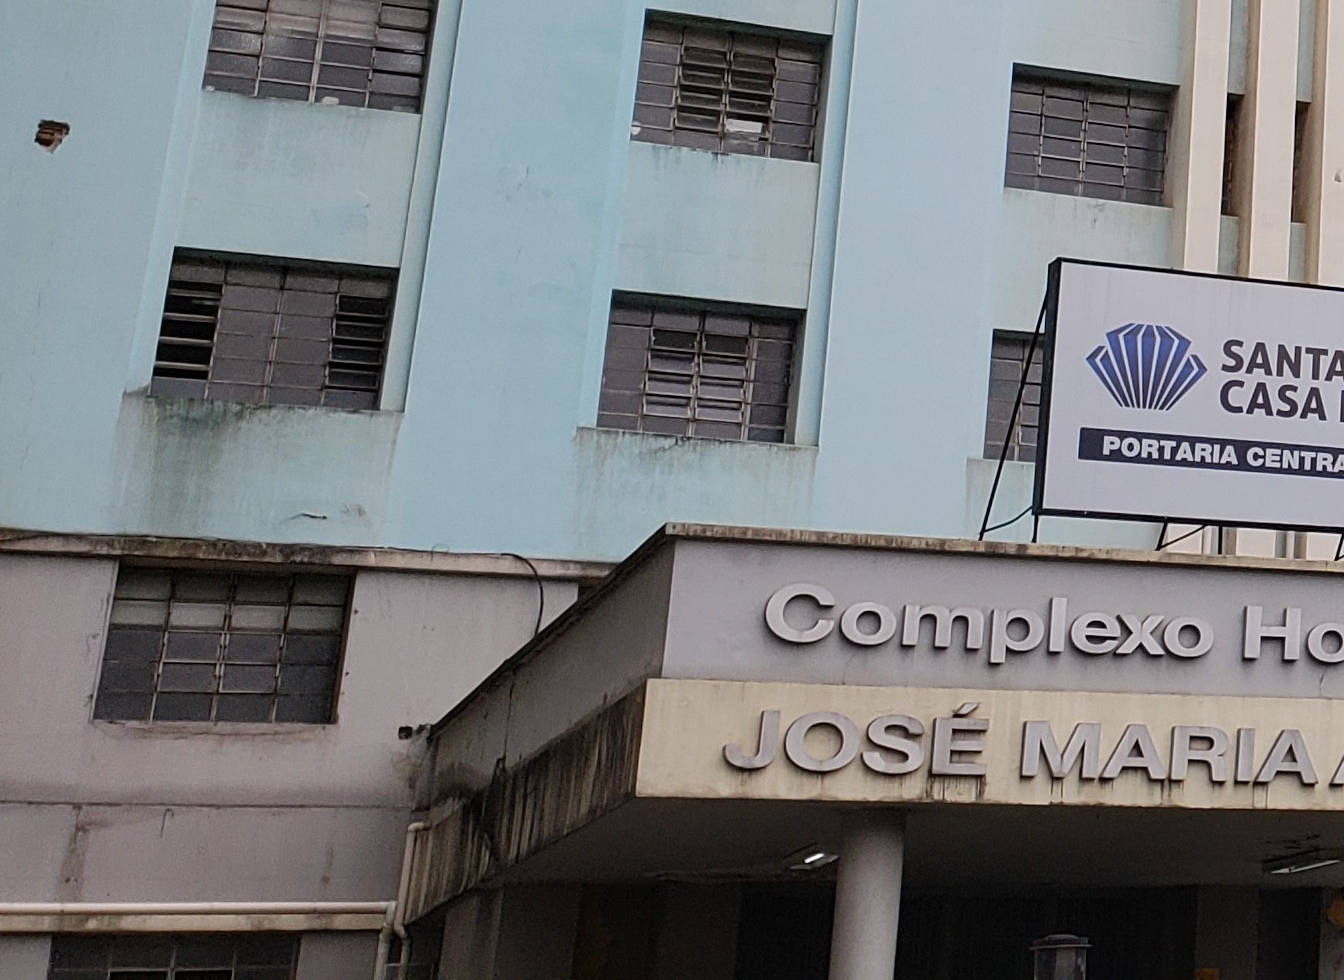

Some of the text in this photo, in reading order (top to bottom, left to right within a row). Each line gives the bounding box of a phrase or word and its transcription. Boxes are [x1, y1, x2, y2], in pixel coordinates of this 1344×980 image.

[1219, 381, 1327, 421] CASA
[1102, 436, 1238, 465] PORTARIA
[764, 583, 1216, 664] Complexo
[722, 703, 990, 777] JOSÉ
[1019, 719, 1318, 786] MARIA
